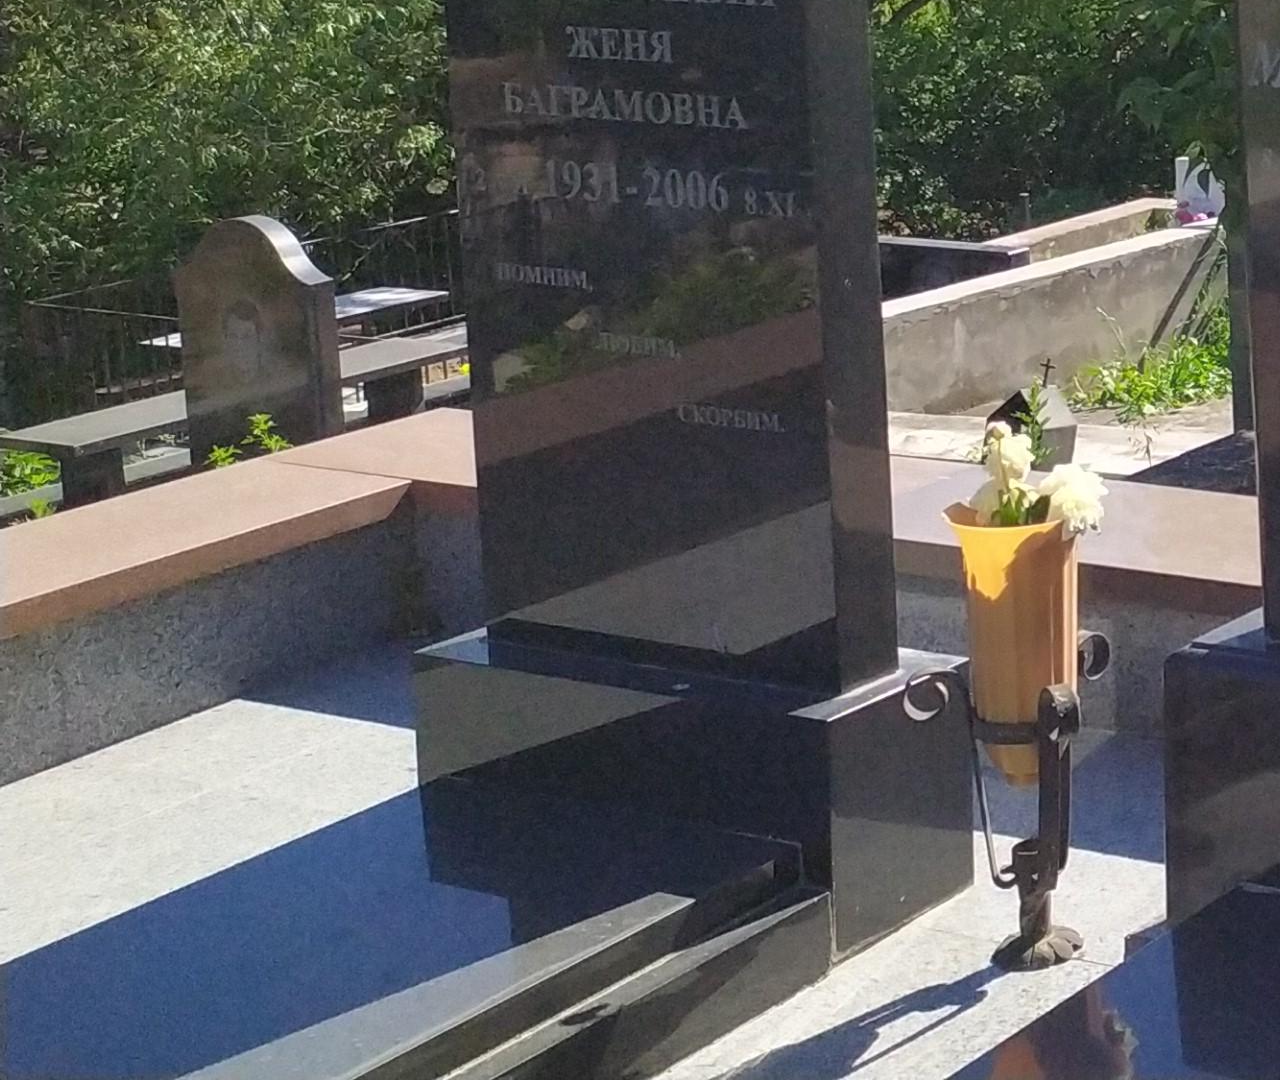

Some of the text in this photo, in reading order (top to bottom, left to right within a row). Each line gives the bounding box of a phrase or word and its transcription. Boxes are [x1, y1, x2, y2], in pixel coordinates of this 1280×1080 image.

[565, 25, 674, 64] ЖЕНЯ
[503, 82, 749, 130] БАГРАМОВНА
[676, 402, 787, 434] СКОРБИМ.
